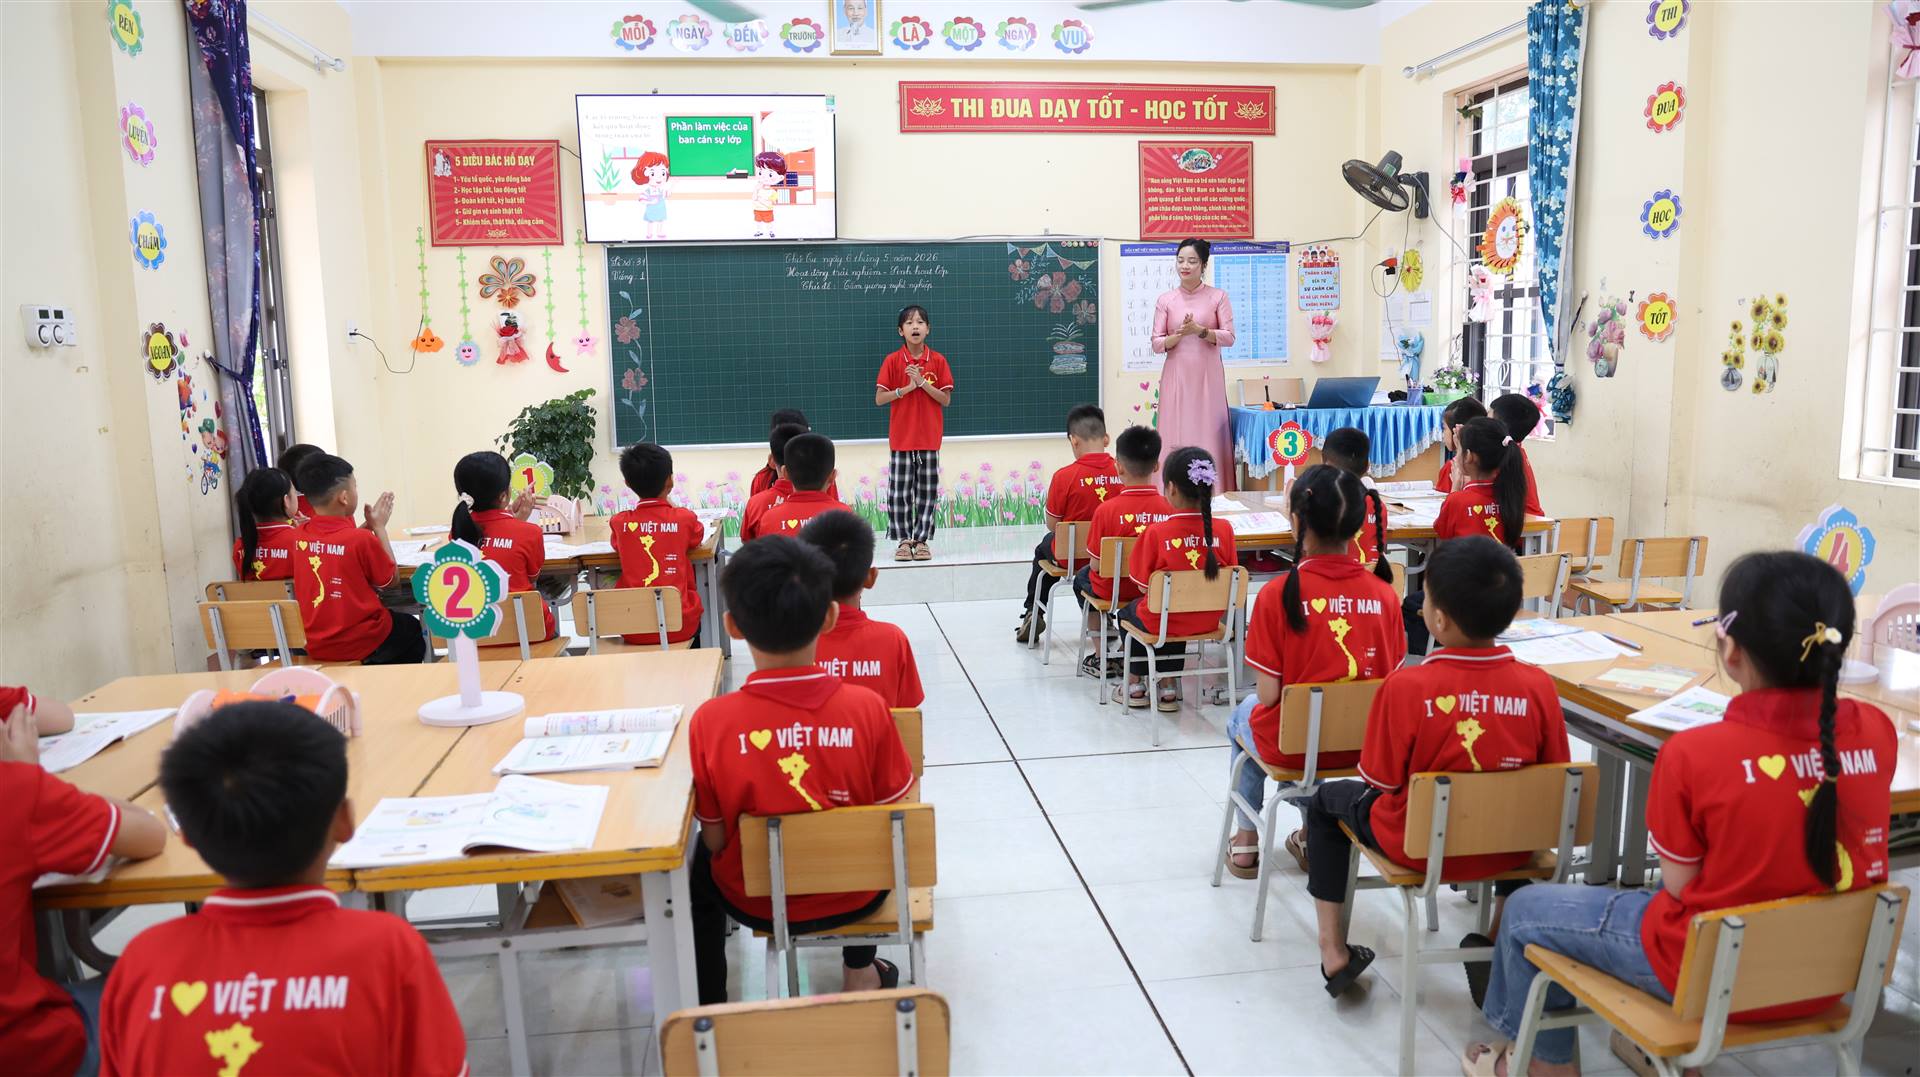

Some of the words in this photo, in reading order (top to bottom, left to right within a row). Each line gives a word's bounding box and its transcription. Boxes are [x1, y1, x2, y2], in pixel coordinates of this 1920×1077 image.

[1661, 5, 1678, 22] THI
[622, 22, 646, 42] MỖI
[675, 26, 705, 40] NGÀY
[734, 26, 759, 43] ĐẾN
[902, 23, 920, 42] LÀ
[952, 26, 975, 43] MỘT
[1062, 31, 1085, 45] VUI
[951, 97, 984, 119] THI
[990, 97, 1034, 119] ĐUA
[1040, 98, 1079, 123] DẠY
[1087, 92, 1124, 119] TỐT
[1145, 100, 1186, 124] HỌC
[1193, 93, 1229, 121] TỐT
[1656, 99, 1676, 116] ĐUA
[671, 120, 693, 131] Phần
[695, 121, 711, 131] làm
[713, 121, 731, 132] việc
[733, 120, 748, 131] của
[697, 134, 713, 144] cán
[715, 135, 725, 144] sự
[727, 135, 742, 145] lớp
[455, 156, 461, 166] 5
[463, 152, 483, 166] ĐIỀU
[485, 153, 502, 166] BÁC
[504, 152, 516, 166] HỒ
[518, 156, 535, 168] DẠY
[1652, 208, 1671, 226] HỌC
[823, 255, 843, 267] ngày
[854, 251, 880, 266] tháng
[883, 253, 890, 262] 5
[893, 253, 913, 262] năm
[913, 252, 939, 262] 2026
[786, 266, 808, 280] Hoạt
[852, 265, 882, 280] nghiệm
[934, 265, 949, 278] lớp
[909, 279, 934, 294] nghiệp
[1650, 307, 1668, 324] TỐT
[150, 345, 171, 360] NGOAN
[1283, 431, 1298, 457] 3
[522, 467, 535, 494] 1
[1094, 474, 1108, 486] VIỆT
[1468, 506, 1473, 516] I
[1484, 502, 1500, 516] VIỆT
[781, 520, 786, 530] I
[1120, 515, 1124, 524] I
[1135, 512, 1151, 524] VIỆT
[1153, 514, 1169, 523] NAM
[623, 522, 627, 532] I
[640, 521, 658, 534] VIỆT
[660, 522, 678, 532] NAM
[309, 540, 325, 555] VIỆT
[327, 543, 345, 556] NAM
[493, 538, 513, 549] NAM
[1165, 540, 1171, 551] I
[1184, 534, 1200, 548] VIỆT
[1202, 537, 1220, 548] NM
[256, 546, 268, 559] IỆT
[271, 548, 288, 559] NAM
[1826, 532, 1849, 574] 4
[443, 566, 473, 618] 2
[1302, 600, 1310, 616] I
[1328, 594, 1353, 616] VIỆT
[1357, 598, 1382, 615] NAM
[853, 660, 881, 676] NAM
[1424, 699, 1434, 717] I
[1458, 689, 1490, 716] VIỆT
[1494, 696, 1528, 717] NAM
[738, 733, 748, 754] I
[775, 721, 813, 750] VIỆT
[818, 727, 853, 747] NAM
[1741, 759, 1756, 783] I
[1790, 747, 1825, 783] VIỆ
[1839, 748, 1877, 775] NAM
[149, 985, 166, 1020] I
[213, 972, 279, 1020] VIỆT
[283, 976, 349, 1011] NAM
